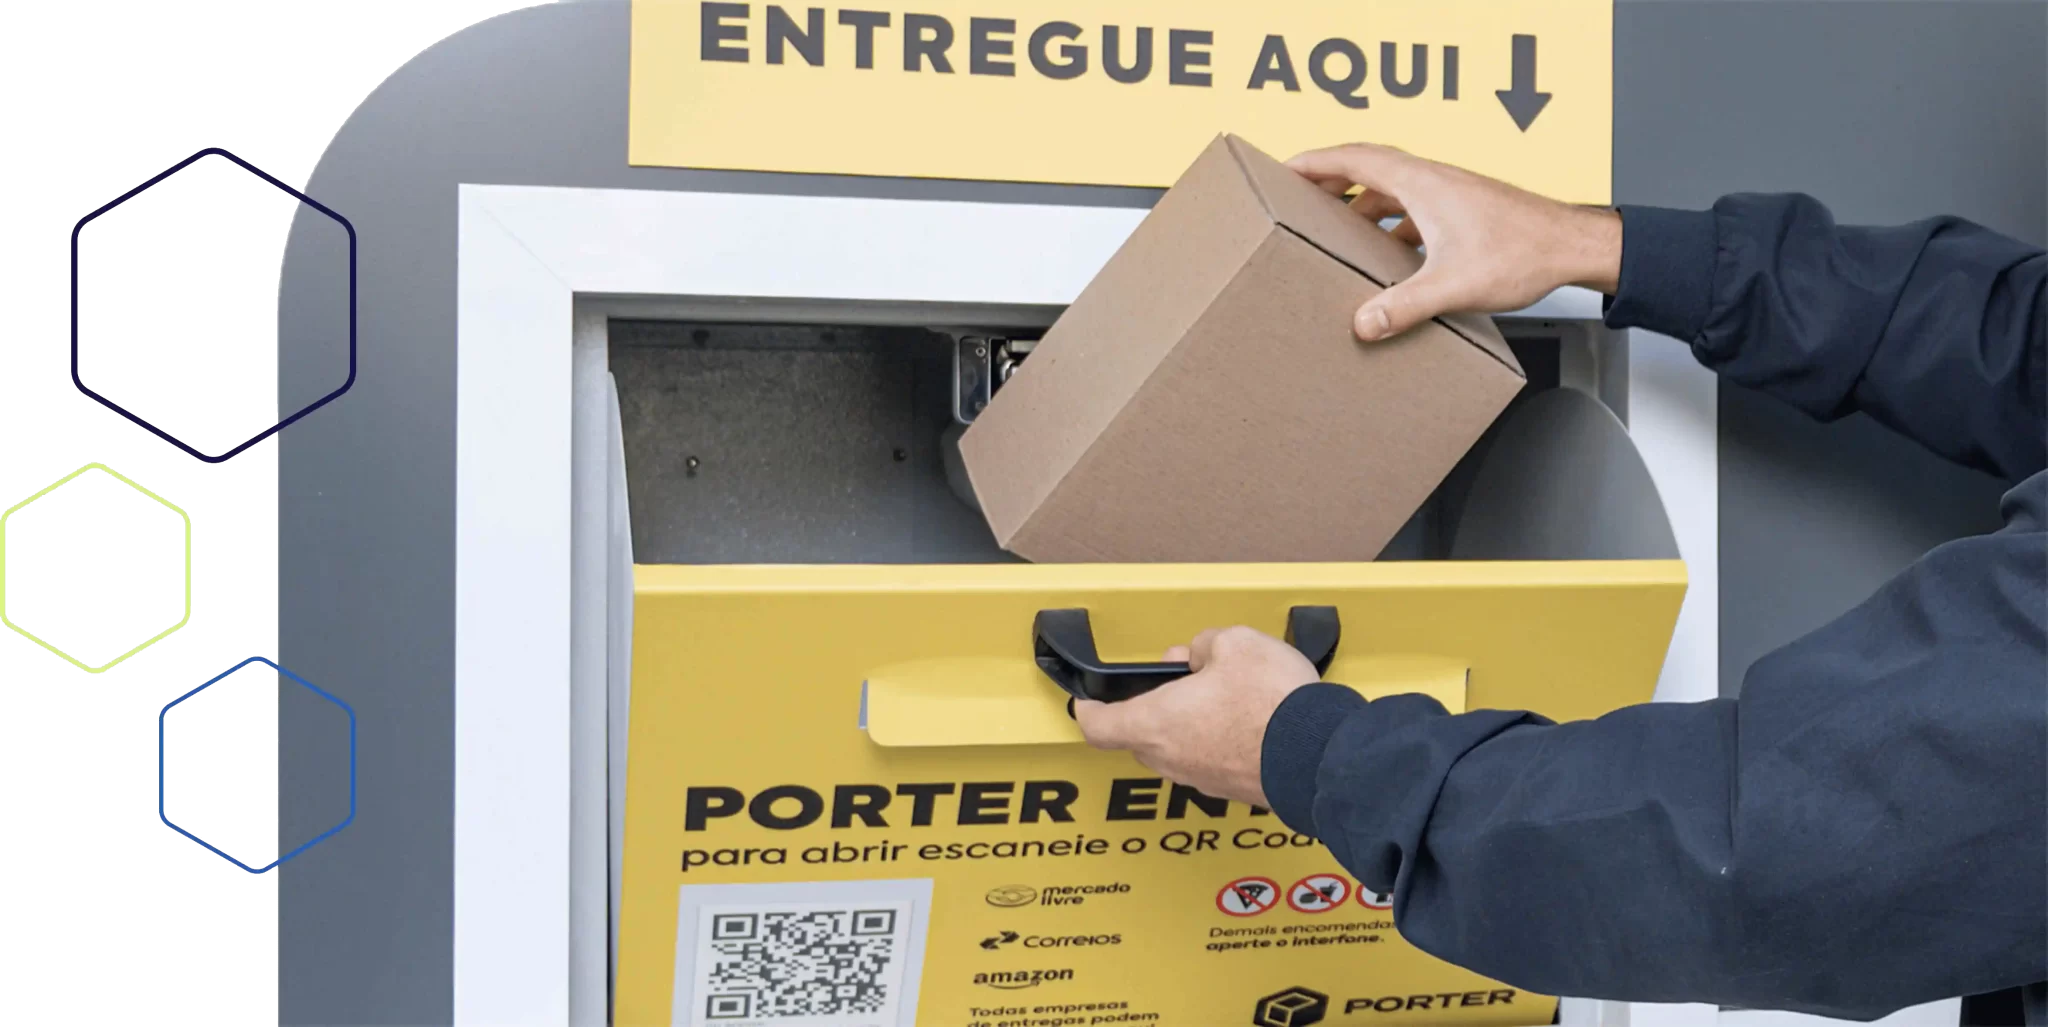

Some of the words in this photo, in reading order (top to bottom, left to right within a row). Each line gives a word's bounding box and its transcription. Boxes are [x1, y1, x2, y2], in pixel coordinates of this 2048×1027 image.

[700, 1, 1214, 87] ENTREGUE
[1247, 34, 1460, 110] AQUI
[684, 781, 1080, 832] PORTER
[1106, 777, 1270, 821] EN
[682, 848, 788, 873] para
[800, 840, 909, 864] abrir
[918, 832, 1110, 860] escaneie
[1121, 837, 1147, 854] o
[1159, 829, 1221, 855] QR
[1043, 882, 1131, 896] mercado
[1209, 926, 1277, 938] Demais
[1023, 933, 1122, 949] Correios
[1206, 936, 1271, 952] aperte
[1276, 938, 1288, 947] o
[972, 968, 1075, 987] amazon
[969, 1006, 1027, 1017] Todas
[1033, 1001, 1129, 1014] empresas
[1344, 989, 1516, 1015] PORTER
[997, 1015, 1086, 1027] entregas
[1090, 1011, 1160, 1024] podem
